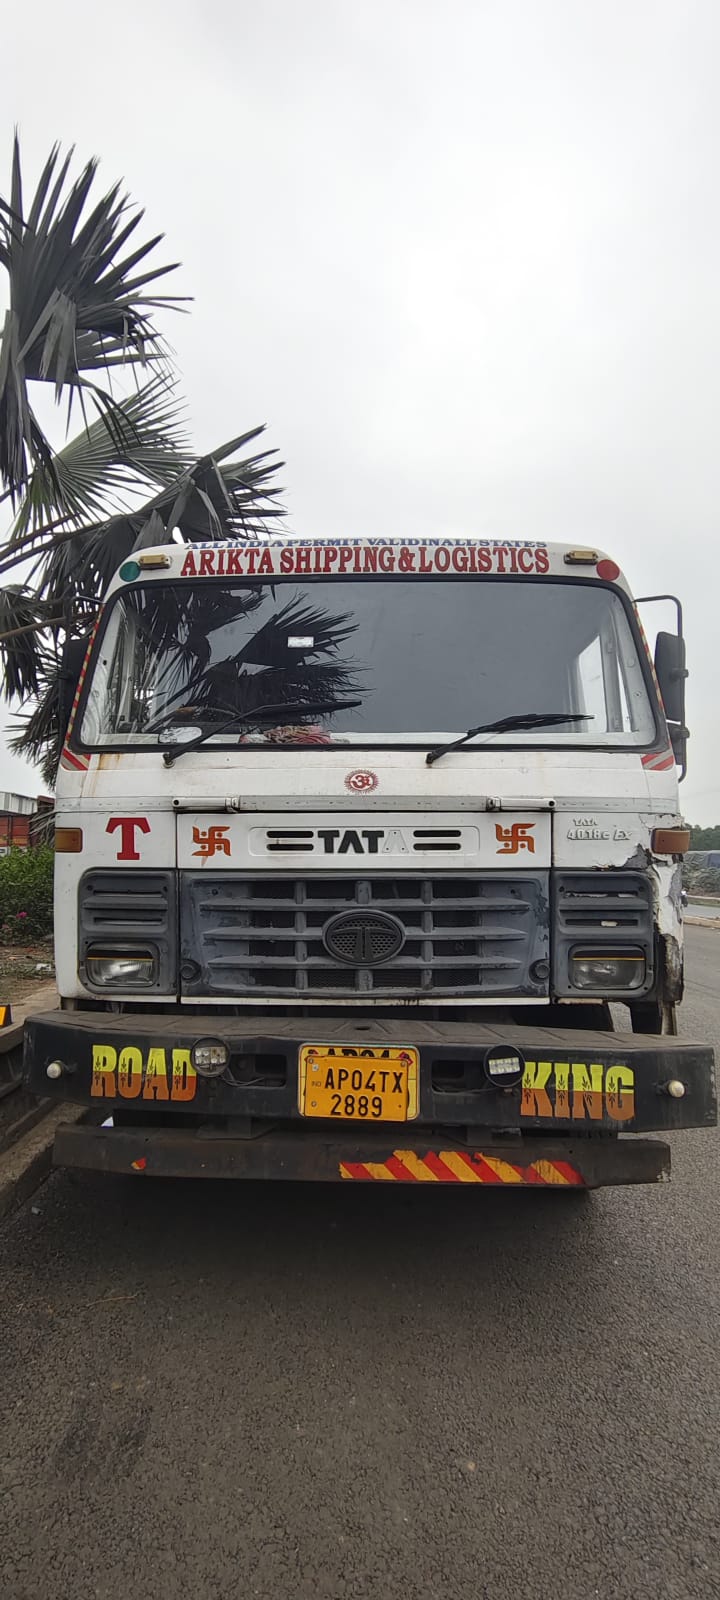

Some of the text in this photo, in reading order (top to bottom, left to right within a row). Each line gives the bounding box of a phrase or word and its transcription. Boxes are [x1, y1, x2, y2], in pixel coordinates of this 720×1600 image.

[284, 538, 363, 547] PERMIT
[180, 548, 274, 576] ARIKTA
[105, 817, 151, 860] T
[90, 1045, 197, 1101] ROAD
[325, 1068, 403, 1093] AP04TX
[520, 1061, 635, 1121] KING
[330, 1094, 382, 1117] 2889
